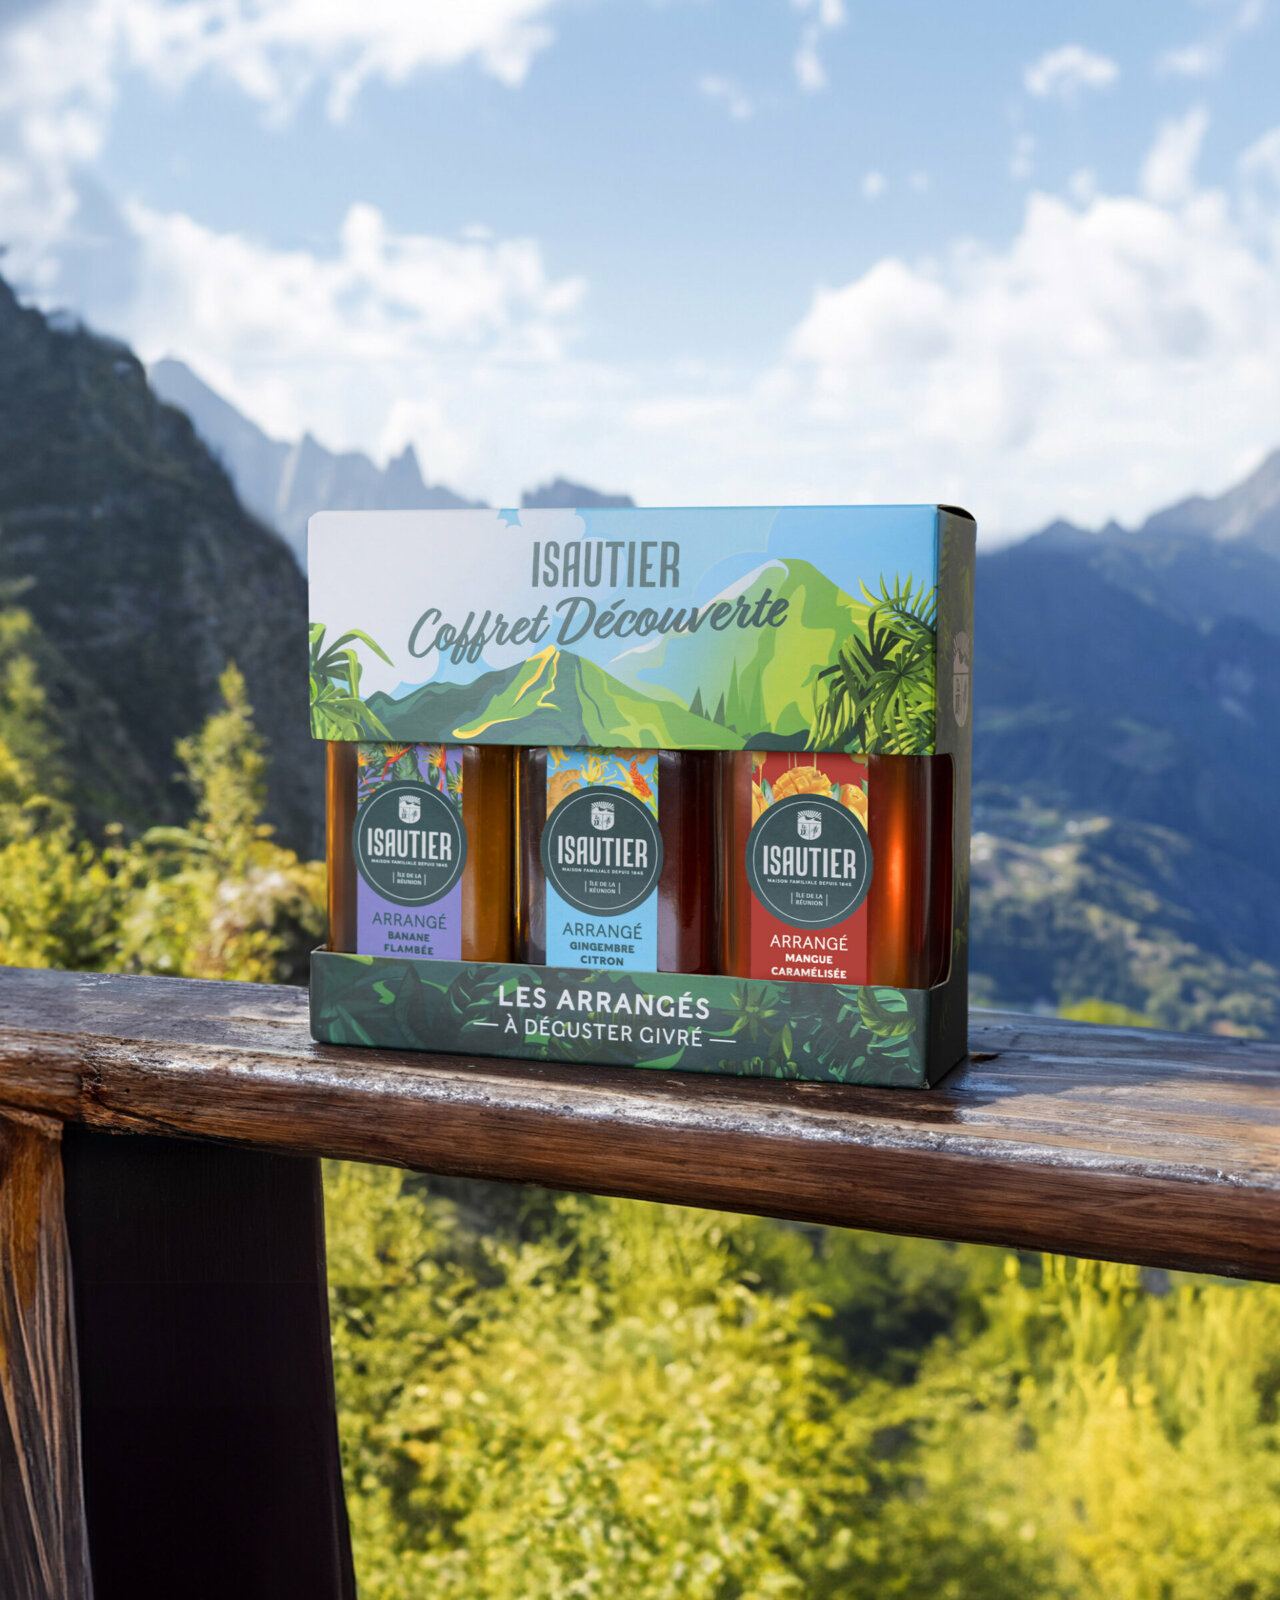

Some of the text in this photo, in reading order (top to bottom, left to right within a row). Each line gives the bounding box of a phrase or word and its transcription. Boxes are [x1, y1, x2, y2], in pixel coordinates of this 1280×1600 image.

[531, 541, 680, 588] ISAUTIER
[408, 588, 789, 665] Coffret Découverte
[367, 828, 451, 860] ISAUTIER
[558, 835, 648, 868] ISAUTIER
[763, 845, 856, 879] ISAUTIER
[372, 912, 447, 930] ARRANGÉ
[388, 931, 430, 942] BANANE
[562, 922, 642, 940] ARRANGÉ
[384, 944, 434, 955] FLAMBÉE
[570, 941, 635, 954] GINGEMBRE
[770, 934, 848, 951] ARRANGÉ
[580, 955, 624, 966] CITRON
[785, 953, 833, 964] MANGUE
[771, 966, 847, 979] CARAMÉLISÉE
[498, 985, 710, 1020] LES ARRANGÉS
[504, 1013, 702, 1047] À DÉGUSTER GIVRÉ
